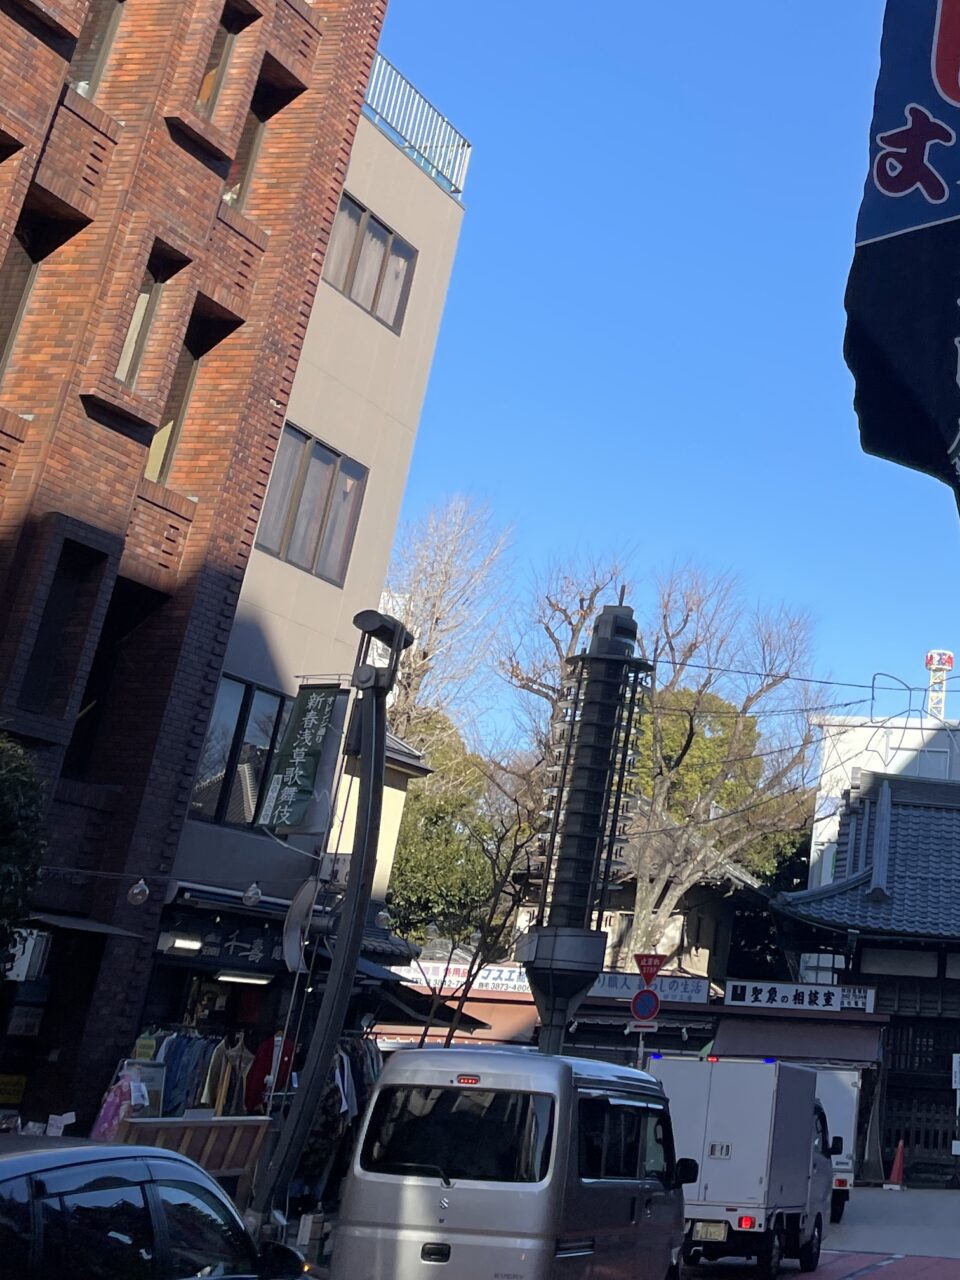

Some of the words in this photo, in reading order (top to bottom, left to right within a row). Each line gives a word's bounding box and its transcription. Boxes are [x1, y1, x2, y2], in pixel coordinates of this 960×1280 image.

[272, 692, 326, 826] 新春浅草歌舞伎
[315, 696, 335, 744] オレンジ通り
